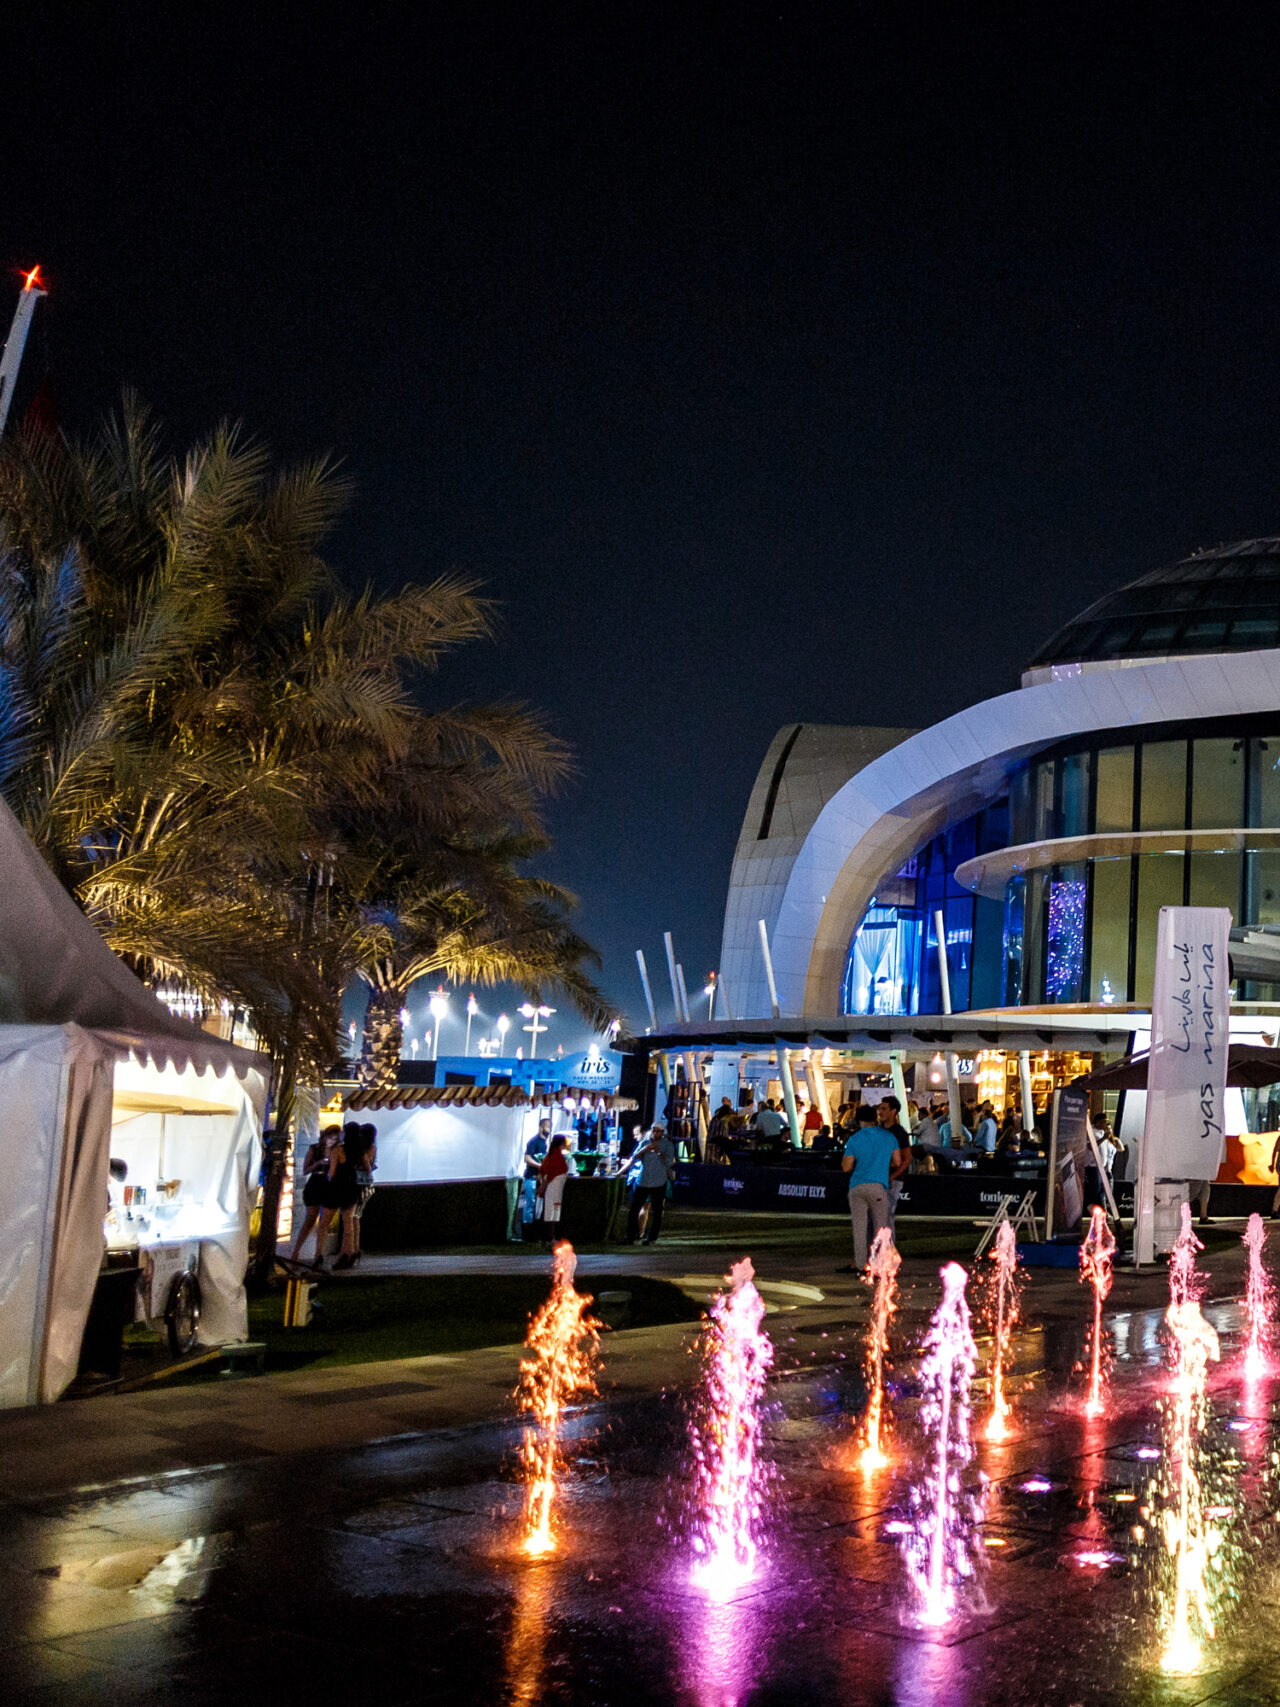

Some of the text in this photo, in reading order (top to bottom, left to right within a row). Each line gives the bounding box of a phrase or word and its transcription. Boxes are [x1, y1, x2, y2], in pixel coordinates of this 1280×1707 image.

[1198, 943, 1222, 1139] yas marina
[580, 1057, 611, 1074] iris
[778, 1183, 826, 1199] ABSOLUT ELYX
